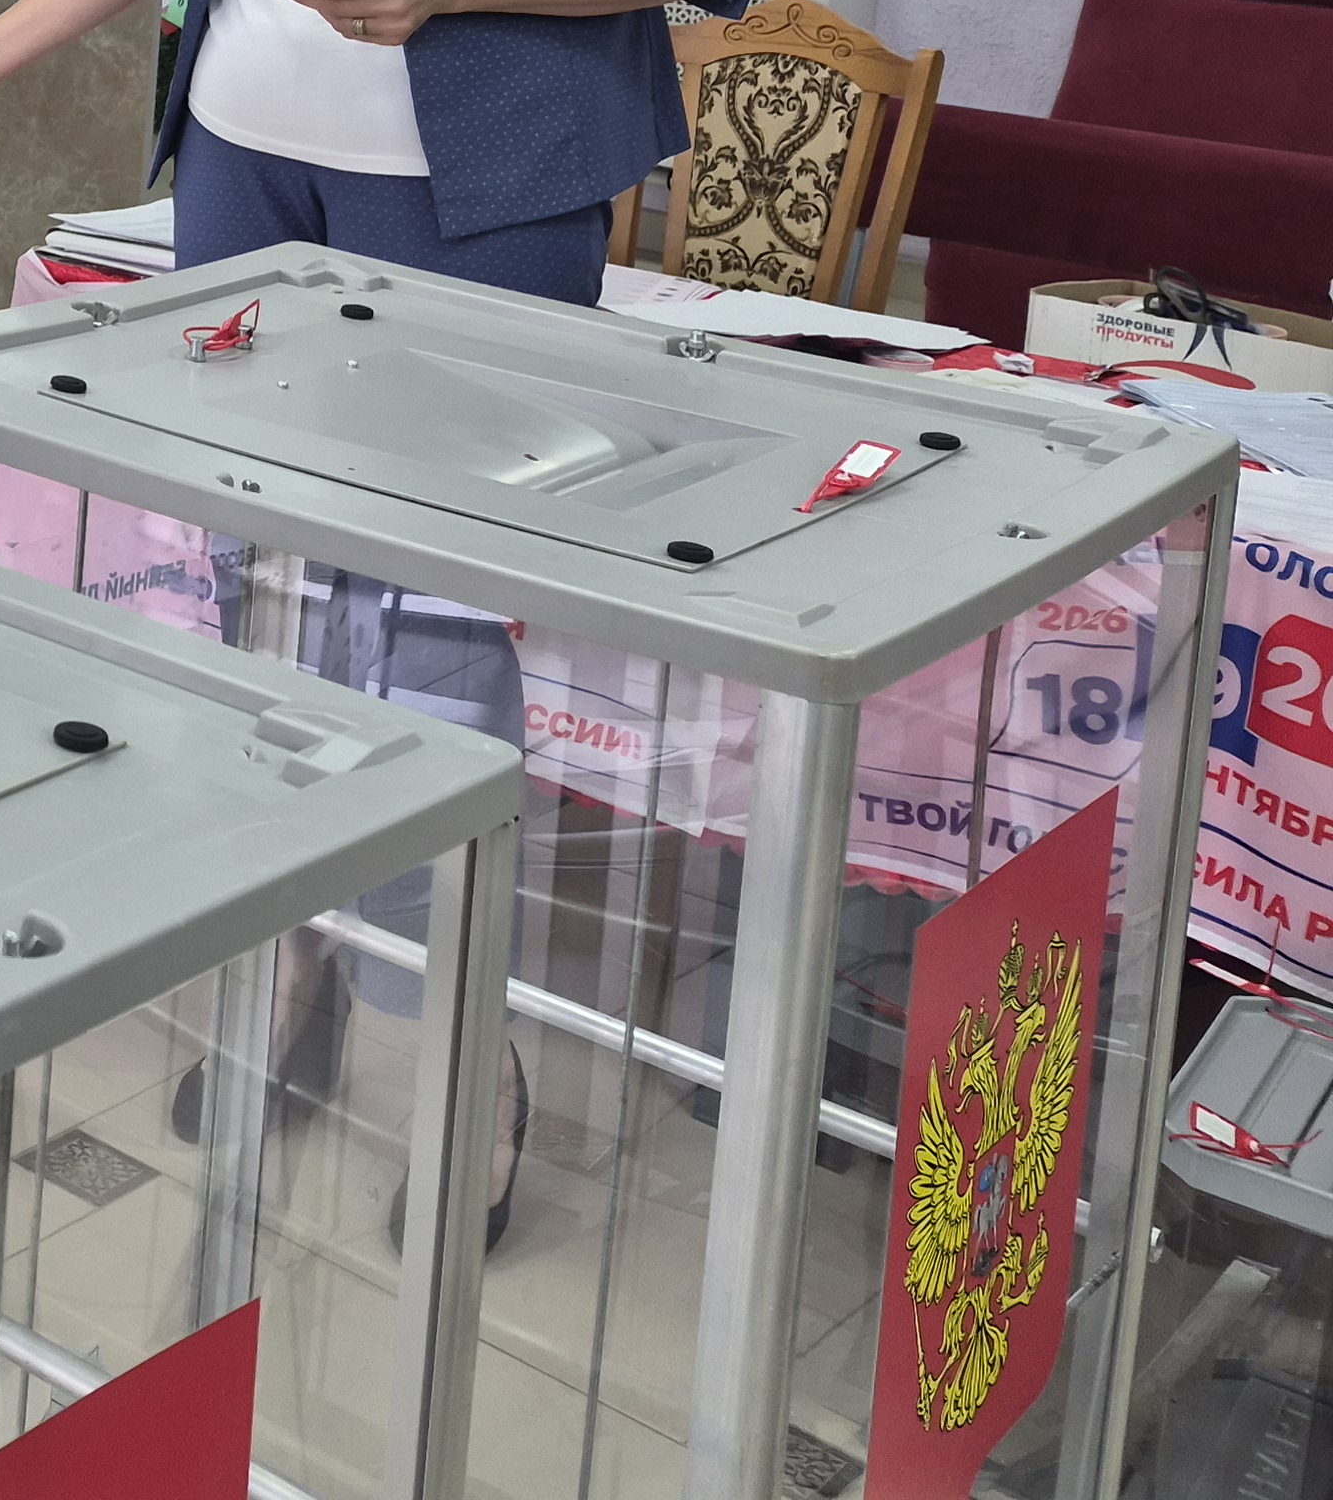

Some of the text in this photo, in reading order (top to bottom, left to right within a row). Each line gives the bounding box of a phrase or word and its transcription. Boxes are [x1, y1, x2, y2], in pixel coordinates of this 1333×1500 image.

[1096, 313, 1175, 337] ЗДОРОВЫЕ
[1096, 325, 1174, 349] ПРОДУКТЫ
[1038, 602, 1128, 634] 2026
[1026, 673, 1123, 745] 18
[1261, 645, 1333, 736] 2
[858, 792, 973, 842] ТВОЙ
